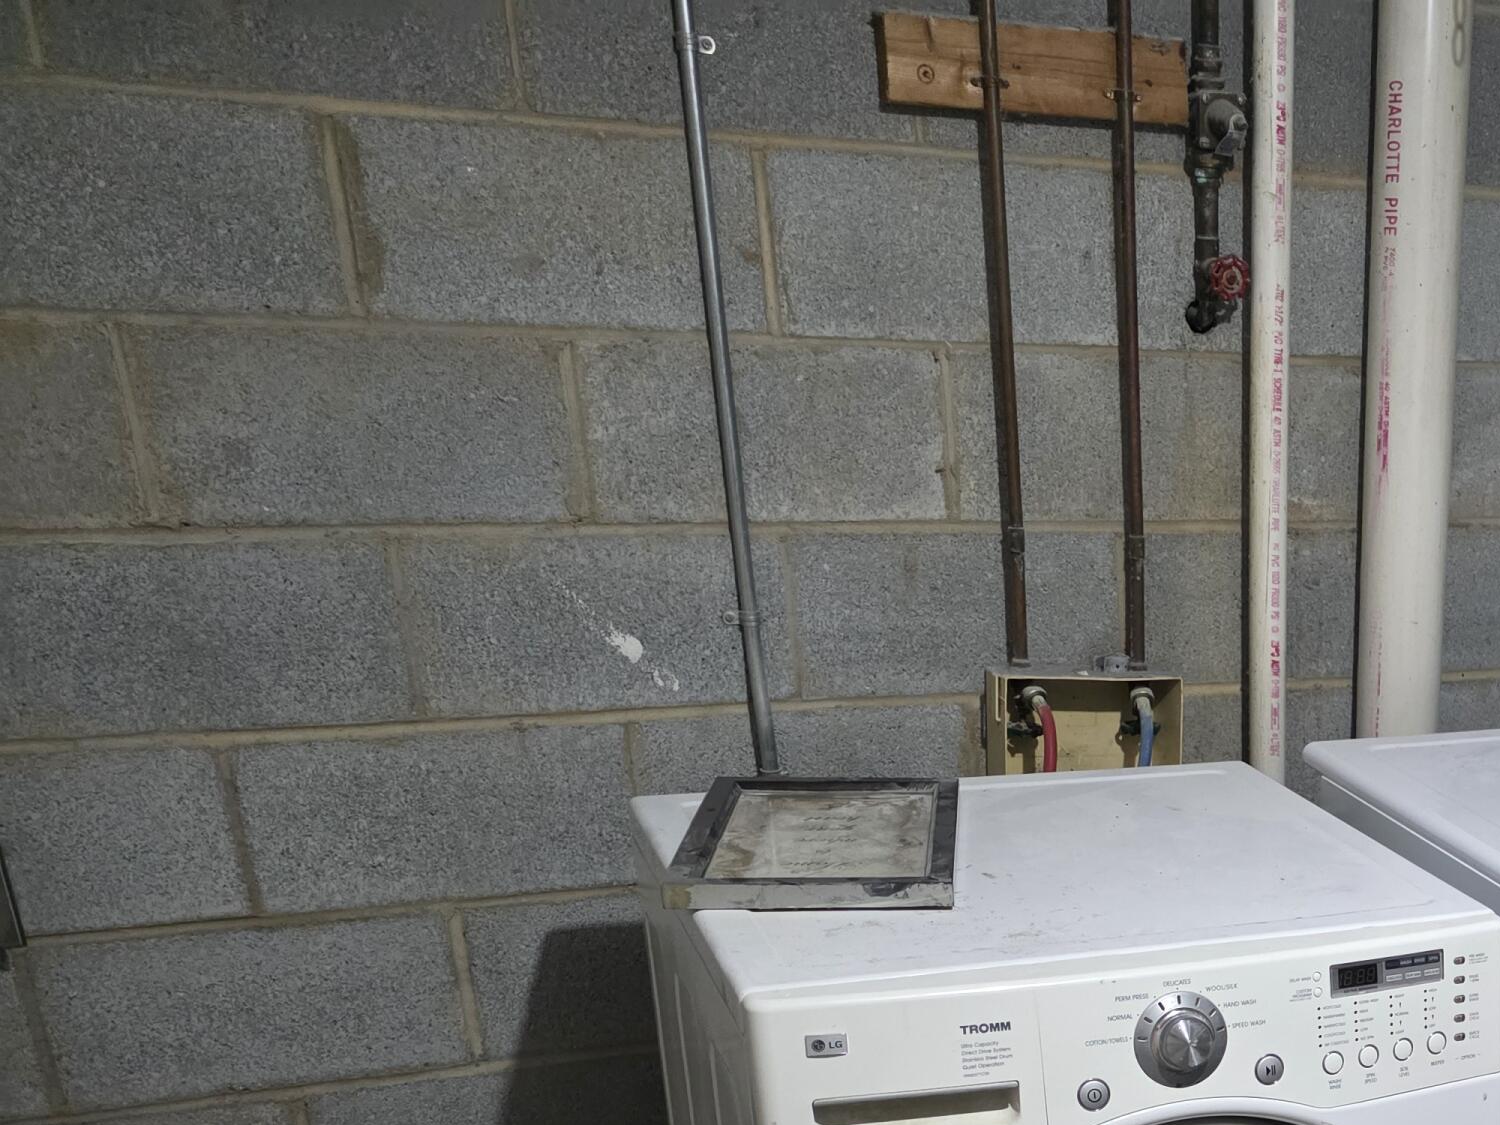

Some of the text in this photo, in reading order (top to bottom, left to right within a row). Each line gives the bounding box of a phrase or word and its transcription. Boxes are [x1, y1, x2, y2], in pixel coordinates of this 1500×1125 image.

[1383, 80, 1403, 237] CHARLOTTE PIPE
[1162, 978, 1192, 987] DELICATES
[1114, 993, 1149, 1003] PERM PRESS
[1223, 998, 1257, 1009] HAND WASH
[1107, 1013, 1133, 1022] NORMAL
[959, 1021, 1012, 1036] TROMM
[1231, 1019, 1266, 1029] SPEED WASH
[828, 1040, 843, 1050] LG
[1085, 1036, 1129, 1048] COTTON/TOWELS
